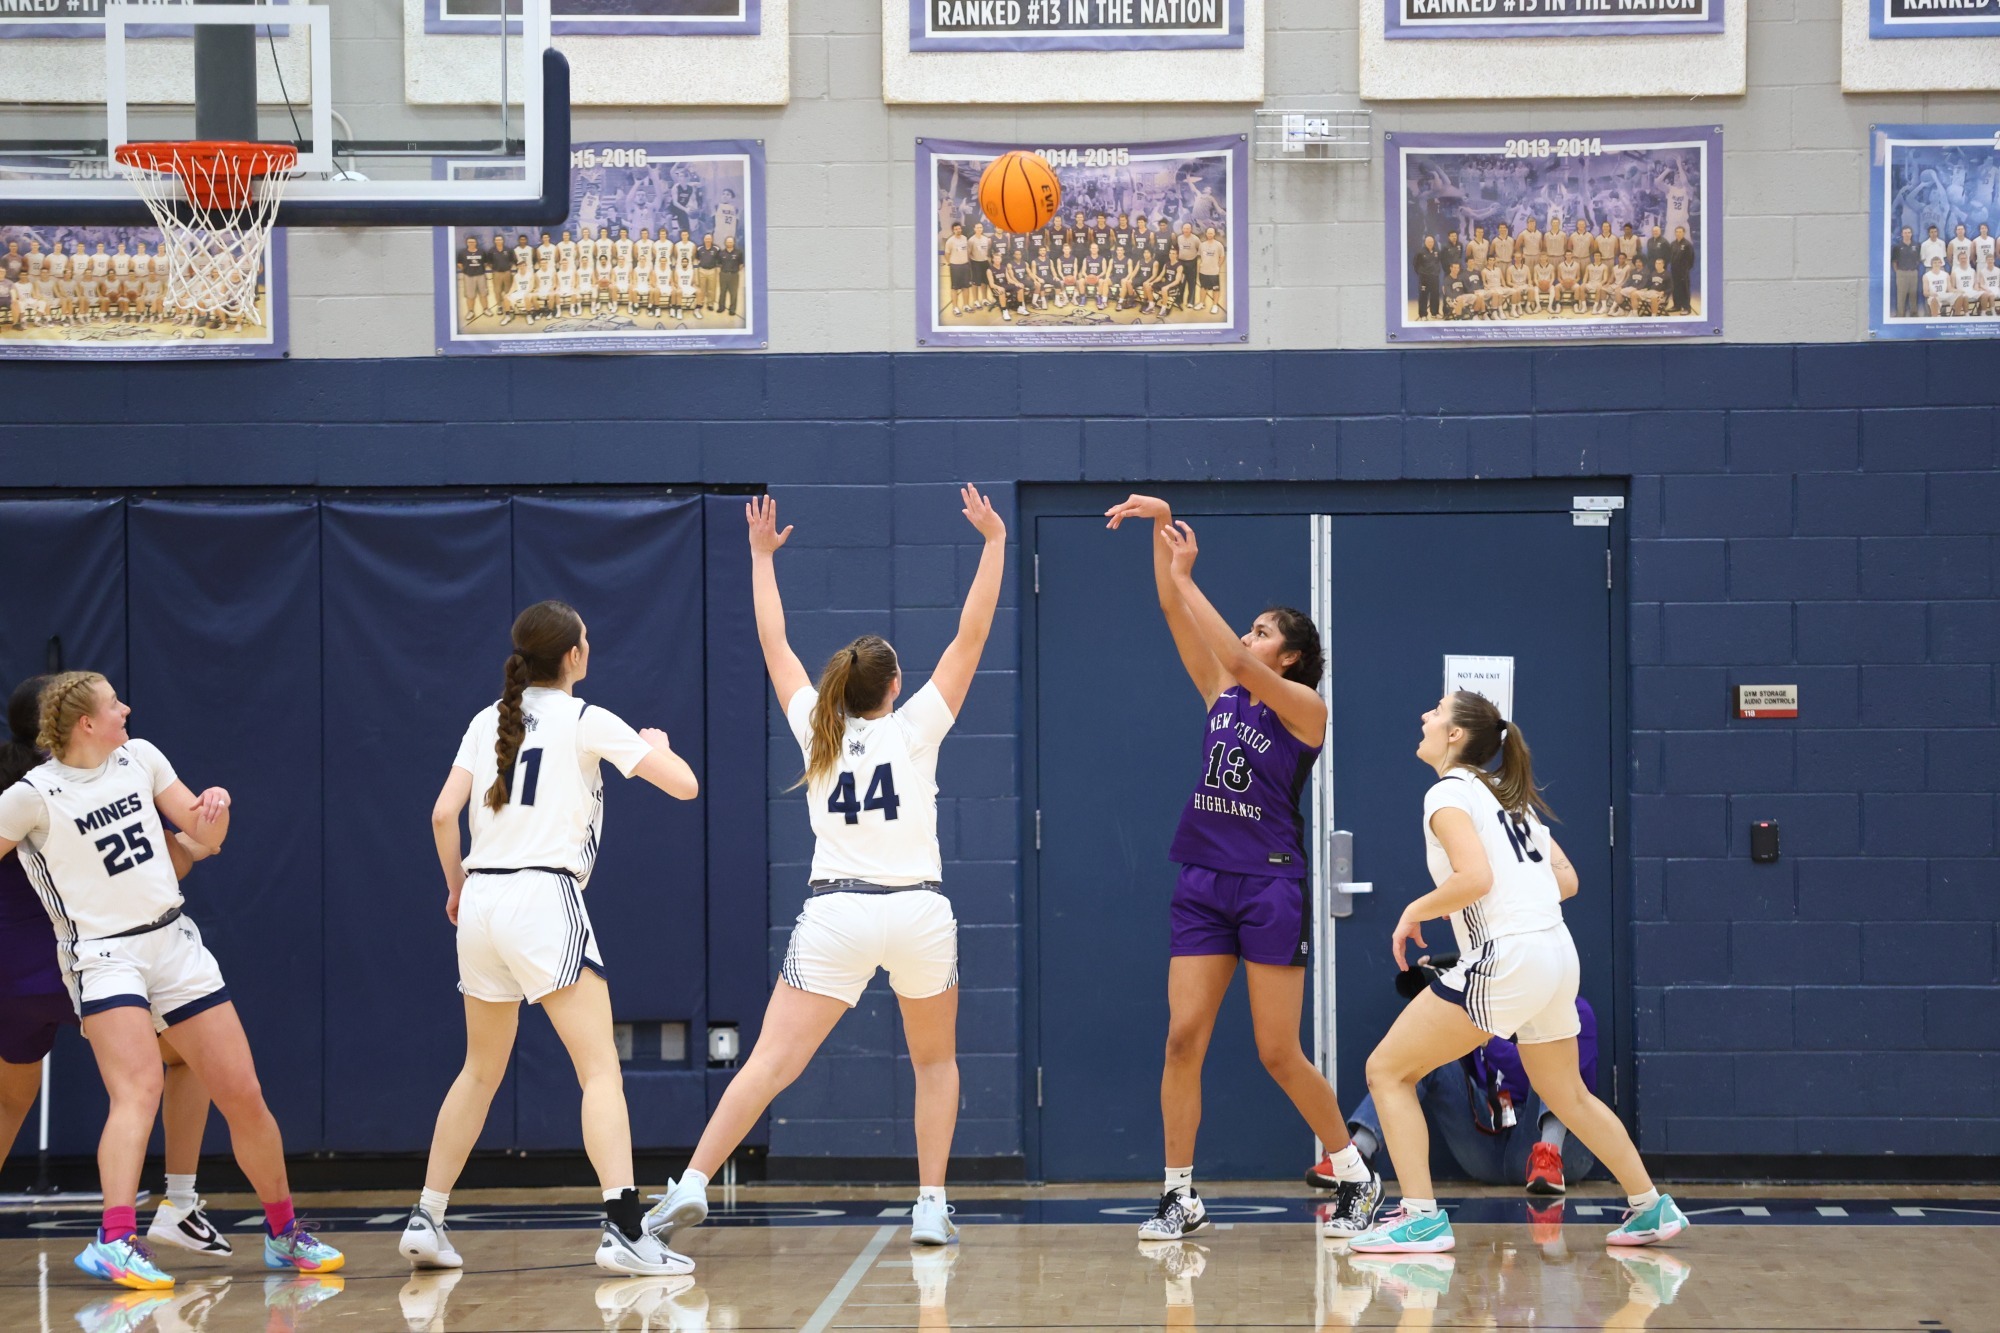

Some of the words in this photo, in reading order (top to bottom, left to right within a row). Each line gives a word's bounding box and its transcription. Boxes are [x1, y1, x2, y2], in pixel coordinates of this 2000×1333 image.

[938, 0, 1021, 25] RANKED
[1027, 0, 1061, 25] #13
[1068, 0, 1089, 24] IN
[1096, 0, 1134, 24] THE
[1141, 0, 1216, 24] NATION
[570, 148, 647, 169] 15-2016
[1505, 137, 1602, 158] 2013-2014
[1210, 712, 1233, 733] NEW
[1204, 741, 1253, 793] 13
[828, 762, 900, 824] 44
[1194, 793, 1262, 821] HIGHLANDS
[74, 792, 142, 836] MINES
[95, 821, 154, 877] 25
